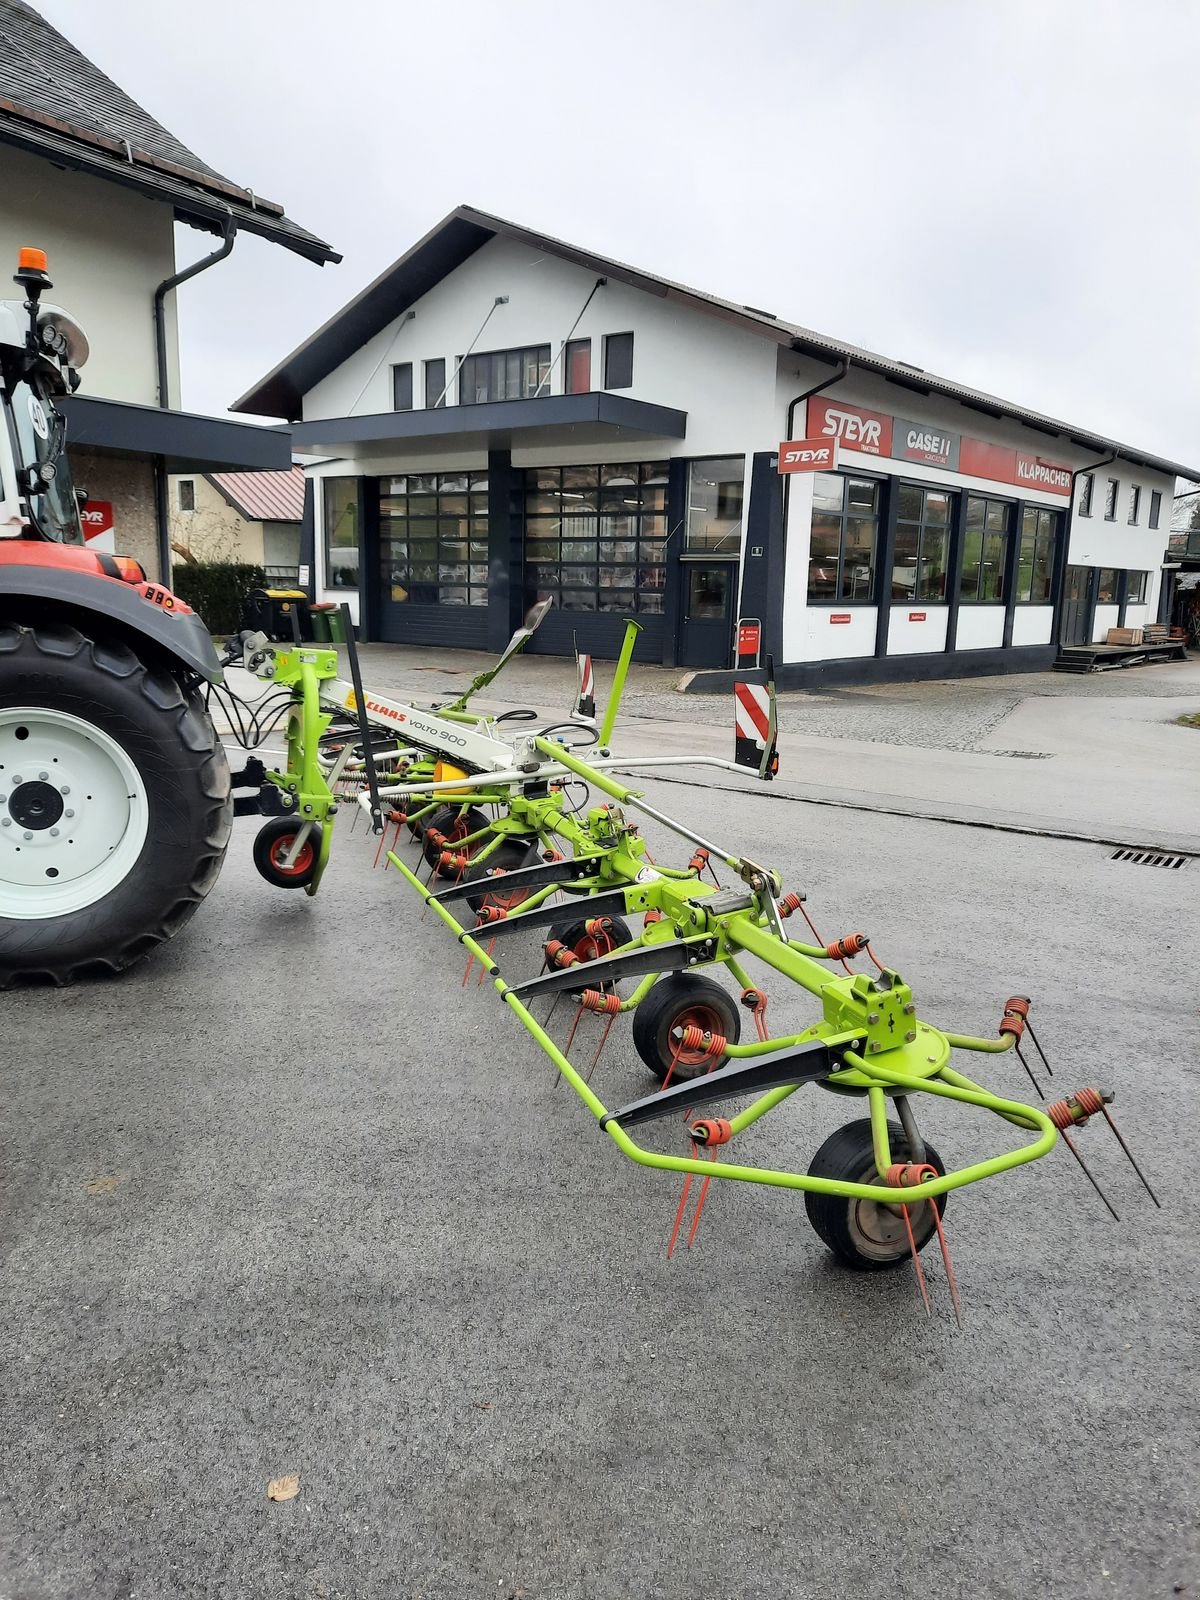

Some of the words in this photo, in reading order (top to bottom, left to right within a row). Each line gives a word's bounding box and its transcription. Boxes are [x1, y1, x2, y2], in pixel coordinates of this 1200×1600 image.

[822, 408, 881, 446] STEYR
[907, 430, 940, 453] CASE
[784, 448, 830, 463] STEYR
[1018, 460, 1070, 488] KLAPPACHER
[80, 510, 104, 522] EYR
[366, 701, 407, 723] CLAAS
[409, 719, 438, 736] VOLTO
[438, 730, 467, 748] 900
